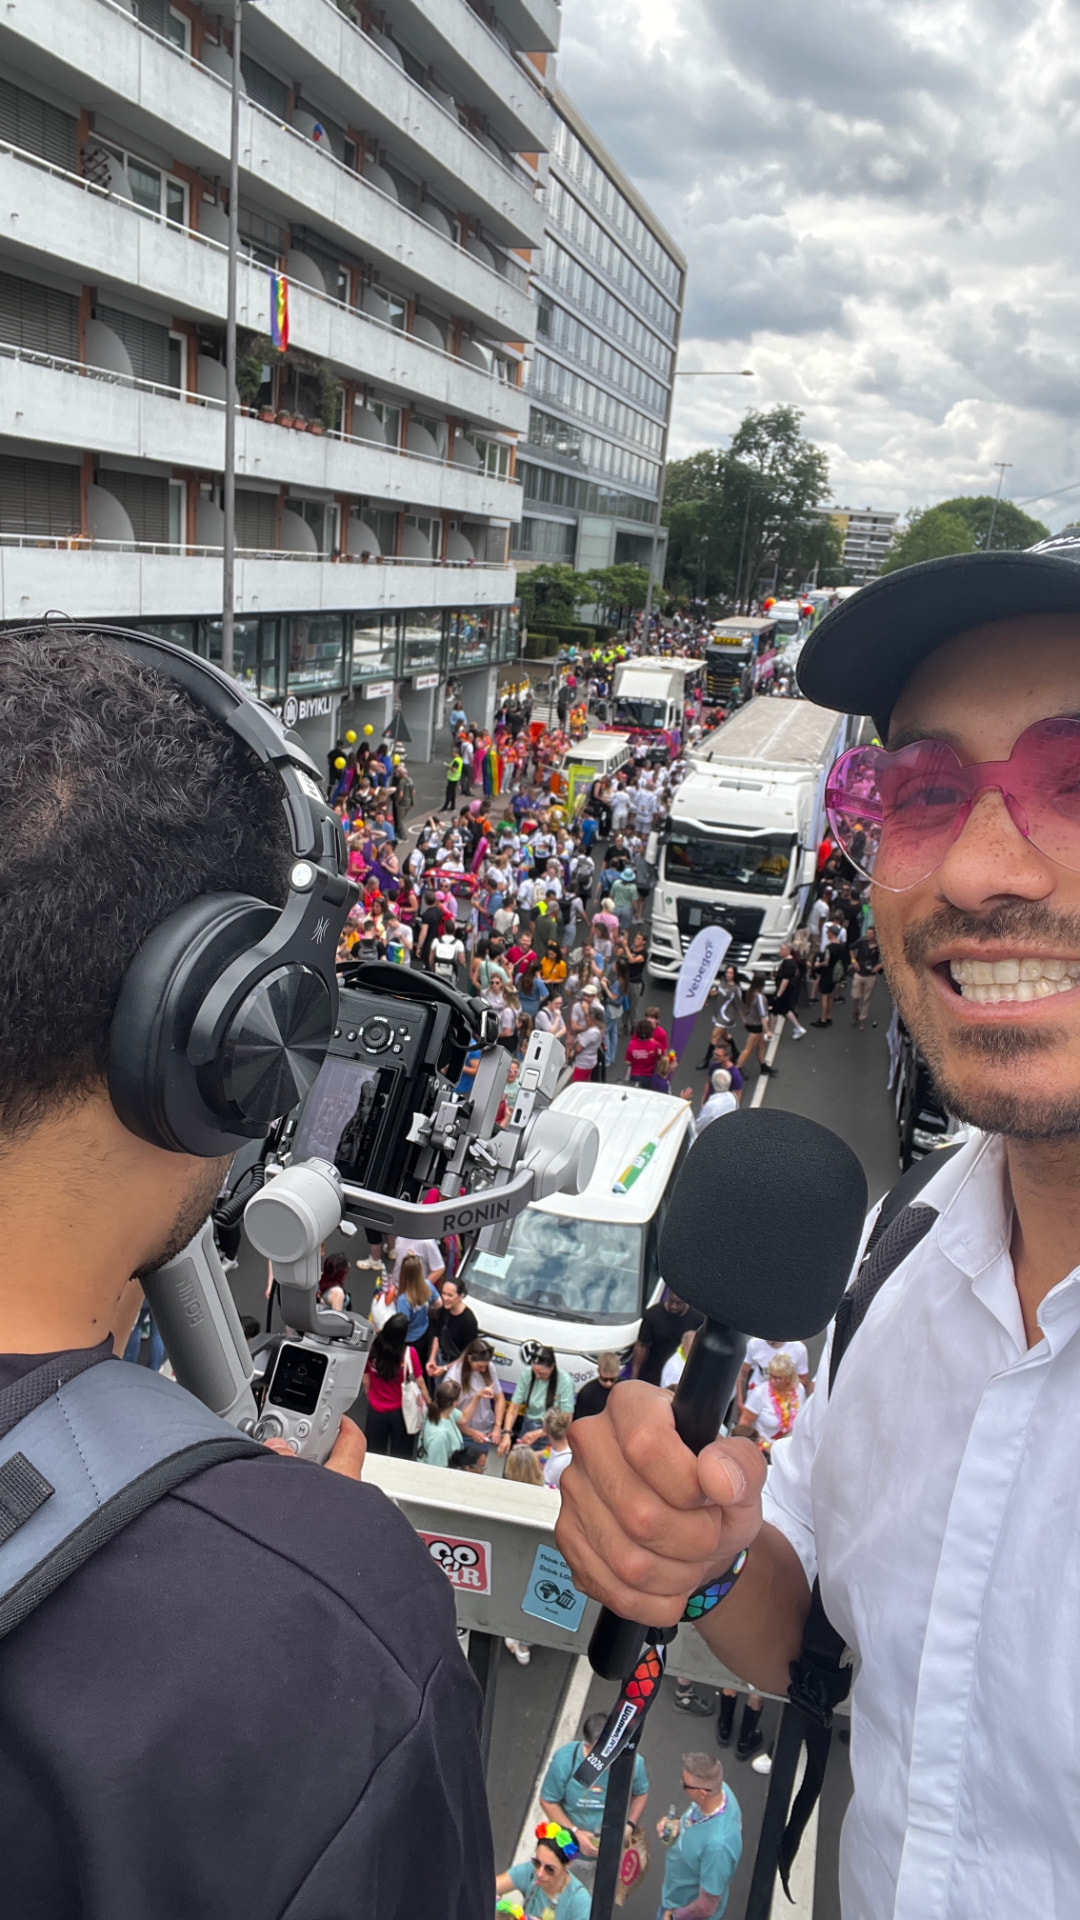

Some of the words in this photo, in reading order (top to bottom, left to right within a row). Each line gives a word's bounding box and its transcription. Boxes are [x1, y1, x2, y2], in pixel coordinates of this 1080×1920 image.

[703, 913, 737, 926] MAN
[685, 949, 713, 999] Vebego
[442, 1199, 511, 1233] RONIN
[586, 1752, 604, 1772] 2026
